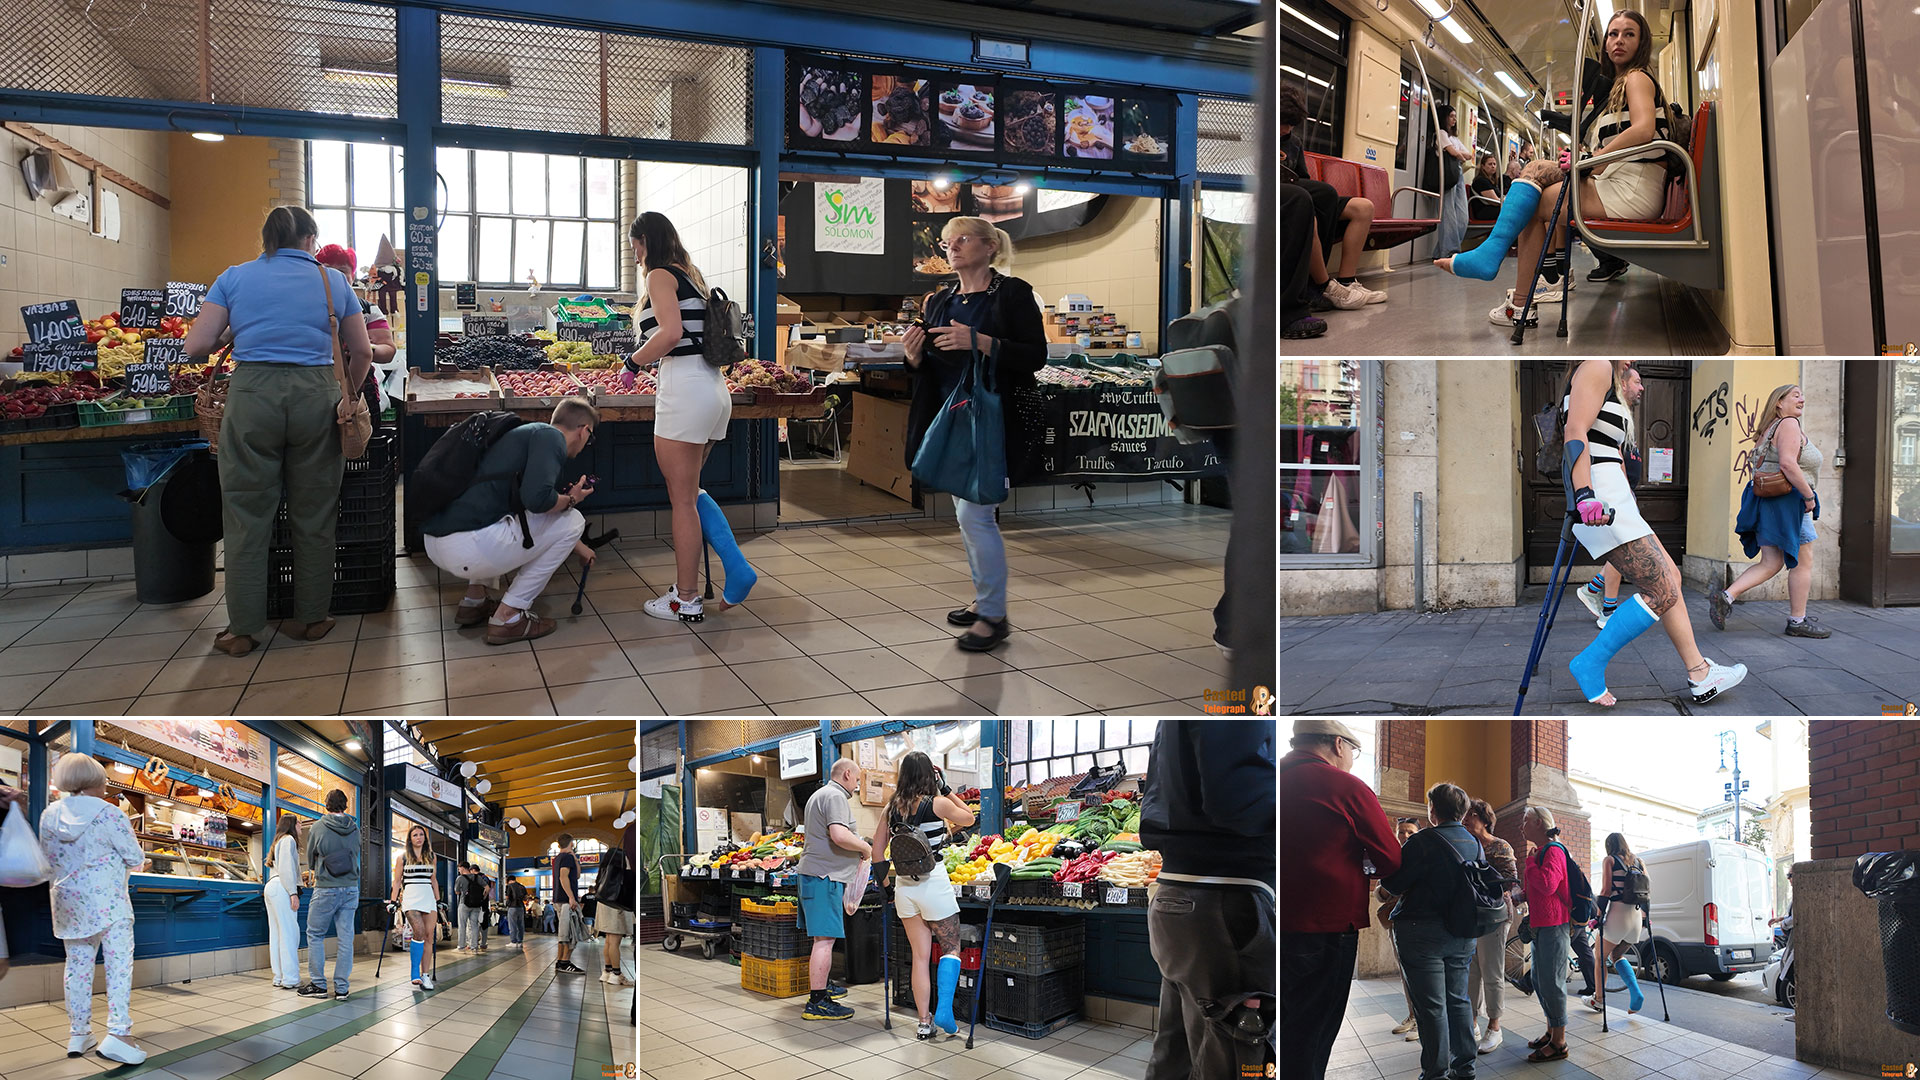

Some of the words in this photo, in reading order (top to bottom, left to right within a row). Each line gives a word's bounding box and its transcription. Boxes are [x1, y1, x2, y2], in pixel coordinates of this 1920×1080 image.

[825, 227, 873, 239] SOLOMON
[25, 302, 68, 315] VAJBAB
[166, 294, 196, 316] 599
[121, 304, 146, 327] 649
[32, 320, 71, 344] 1490
[467, 322, 486, 337] 990
[559, 328, 578, 341] 990
[592, 339, 613, 355] 990
[33, 353, 70, 372] 1790
[146, 347, 177, 363] 1790
[126, 362, 165, 372] UBORKA
[130, 373, 157, 393] 599
[1110, 441, 1147, 453] sauces
[1143, 455, 1184, 470] Tartufo
